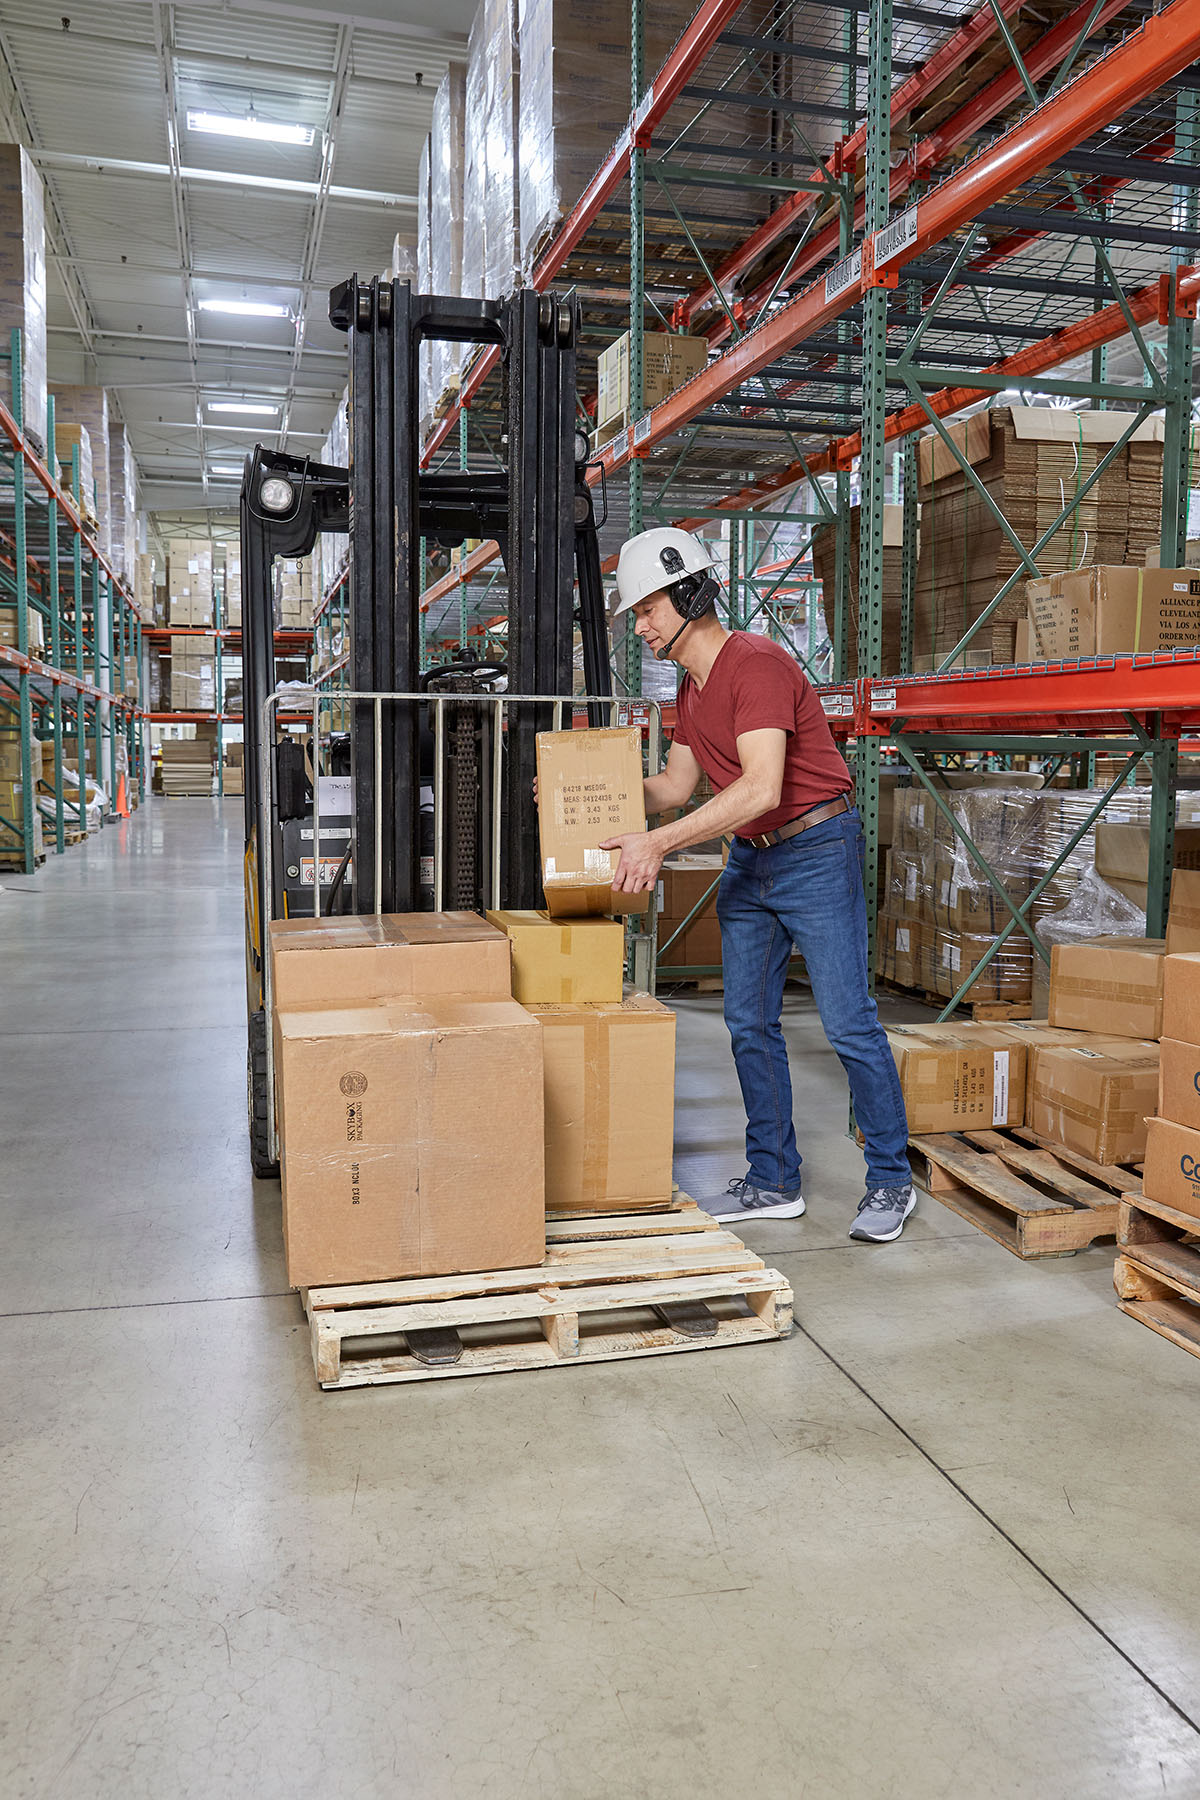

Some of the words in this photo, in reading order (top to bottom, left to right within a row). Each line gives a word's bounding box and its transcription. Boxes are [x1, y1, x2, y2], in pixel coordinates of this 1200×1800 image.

[1159, 621, 1172, 629] VIA
[1176, 621, 1190, 629] LOS
[1159, 632, 1184, 640] ORDER
[347, 1102, 355, 1141] SKYBOX
